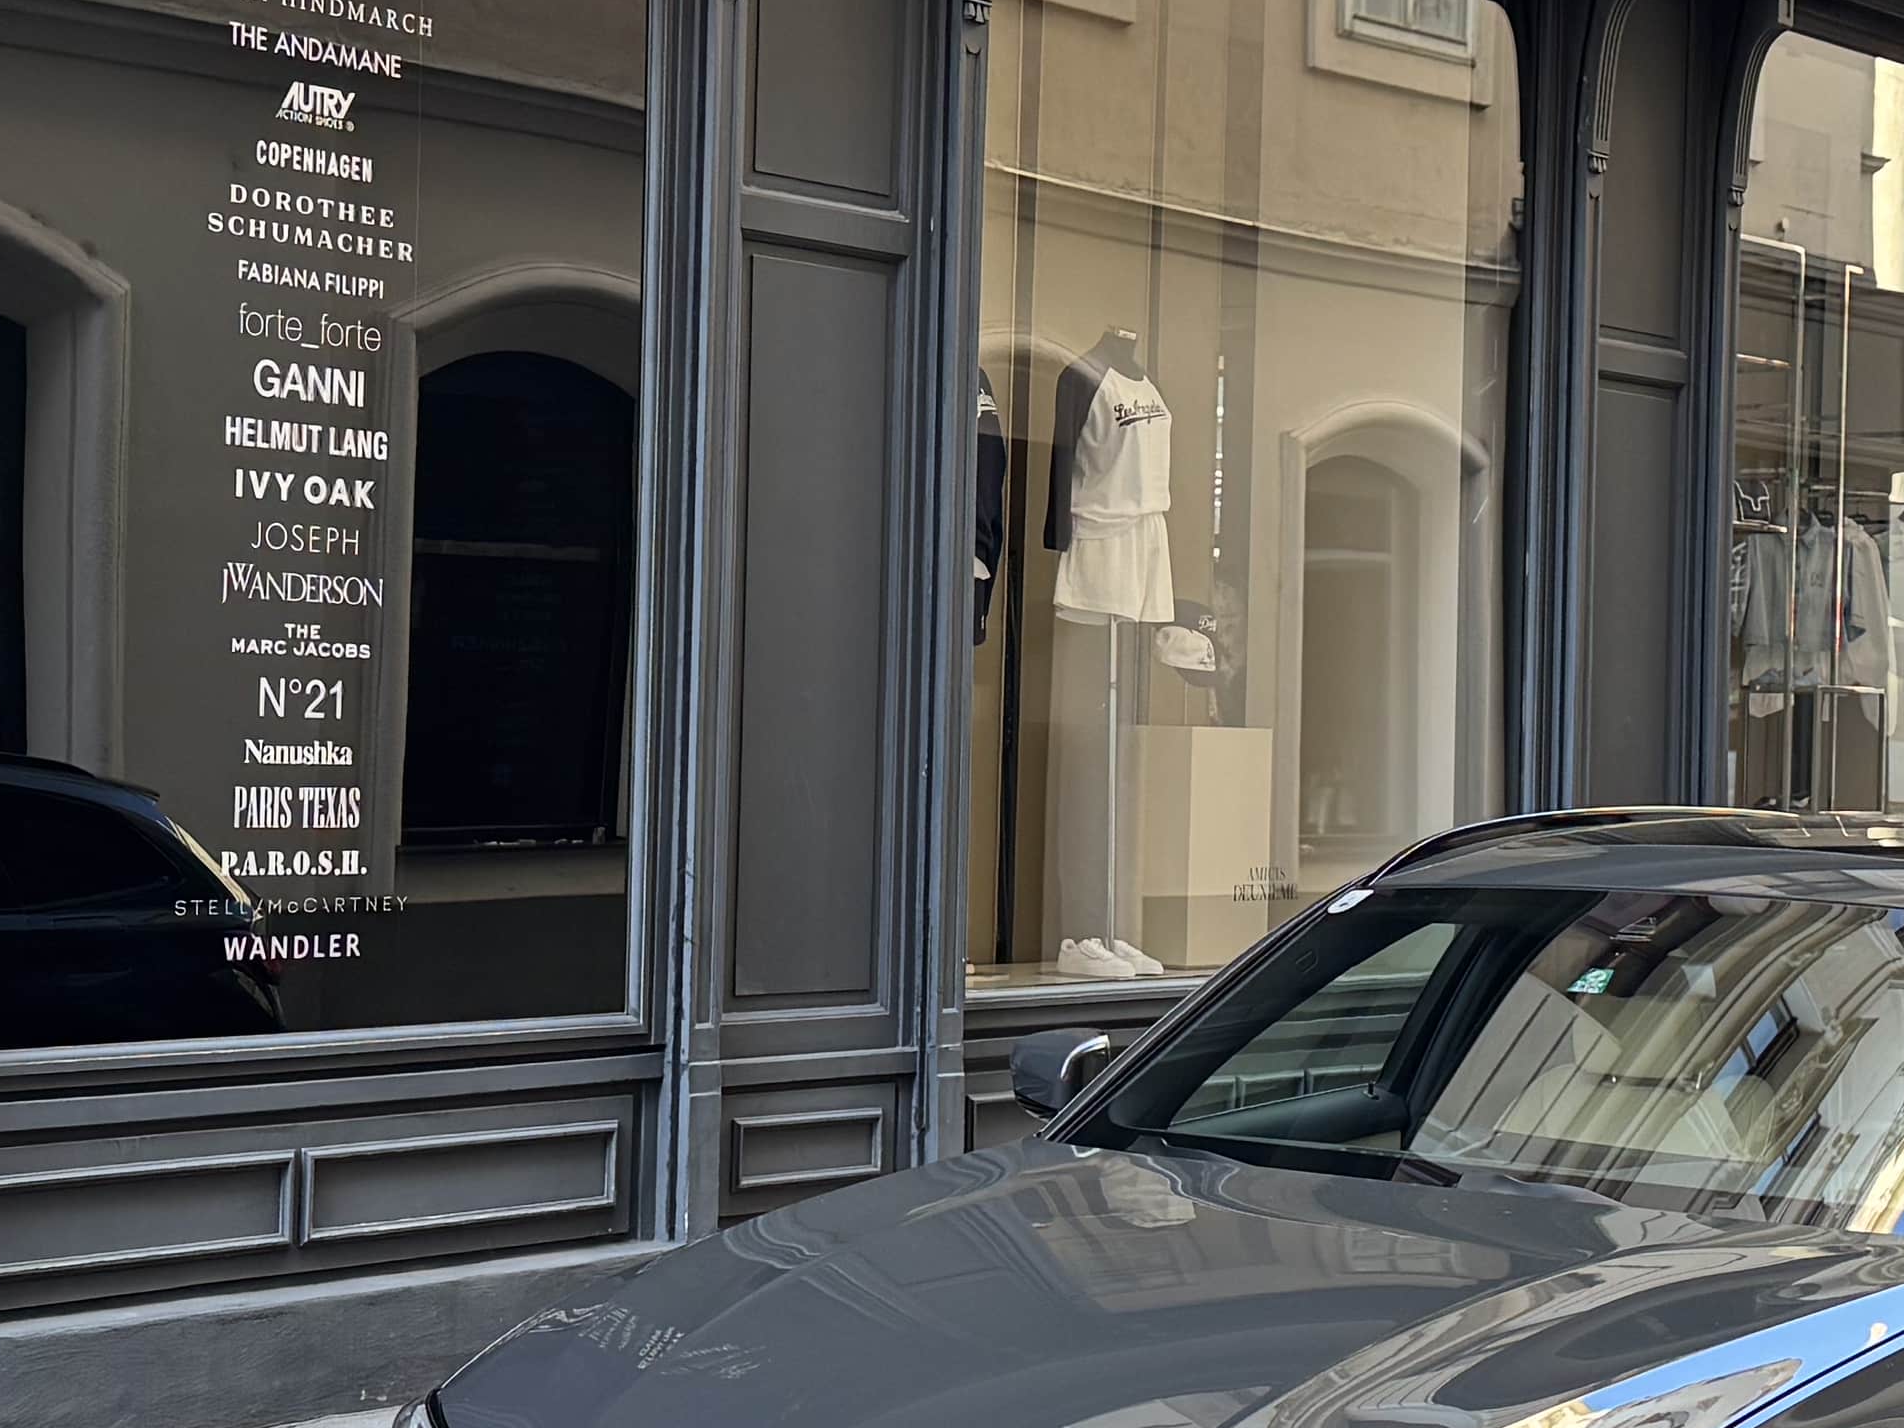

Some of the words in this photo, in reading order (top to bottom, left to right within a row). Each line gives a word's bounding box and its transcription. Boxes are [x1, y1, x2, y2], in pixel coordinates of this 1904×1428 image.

[229, 21, 268, 51] THE
[274, 31, 403, 79] ANDAMANE
[281, 80, 355, 119] AUTRY
[256, 139, 373, 183] COPENHAGEN
[229, 183, 395, 229] DOROTHEE
[207, 211, 414, 263] SCHUMACHER
[238, 259, 321, 291] FABIANA
[325, 272, 384, 299] FILIPPI
[239, 302, 382, 352] forte_forte
[253, 359, 365, 408] GANNI
[225, 415, 322, 454] HELMUT
[329, 426, 389, 461] LANG
[234, 468, 296, 502] IVY
[304, 475, 376, 510] OAK
[251, 521, 360, 556] JOSEPH
[231, 638, 288, 656] MARC
[292, 641, 372, 660] JACOBS
[284, 623, 322, 641] THE
[258, 676, 345, 721] N°21
[244, 738, 353, 767] Nanushka
[234, 785, 293, 829] PARIS
[298, 786, 361, 830] TEXAS
[220, 850, 368, 877] P.A.R.O.S.H.
[223, 933, 361, 962] WANDLER
